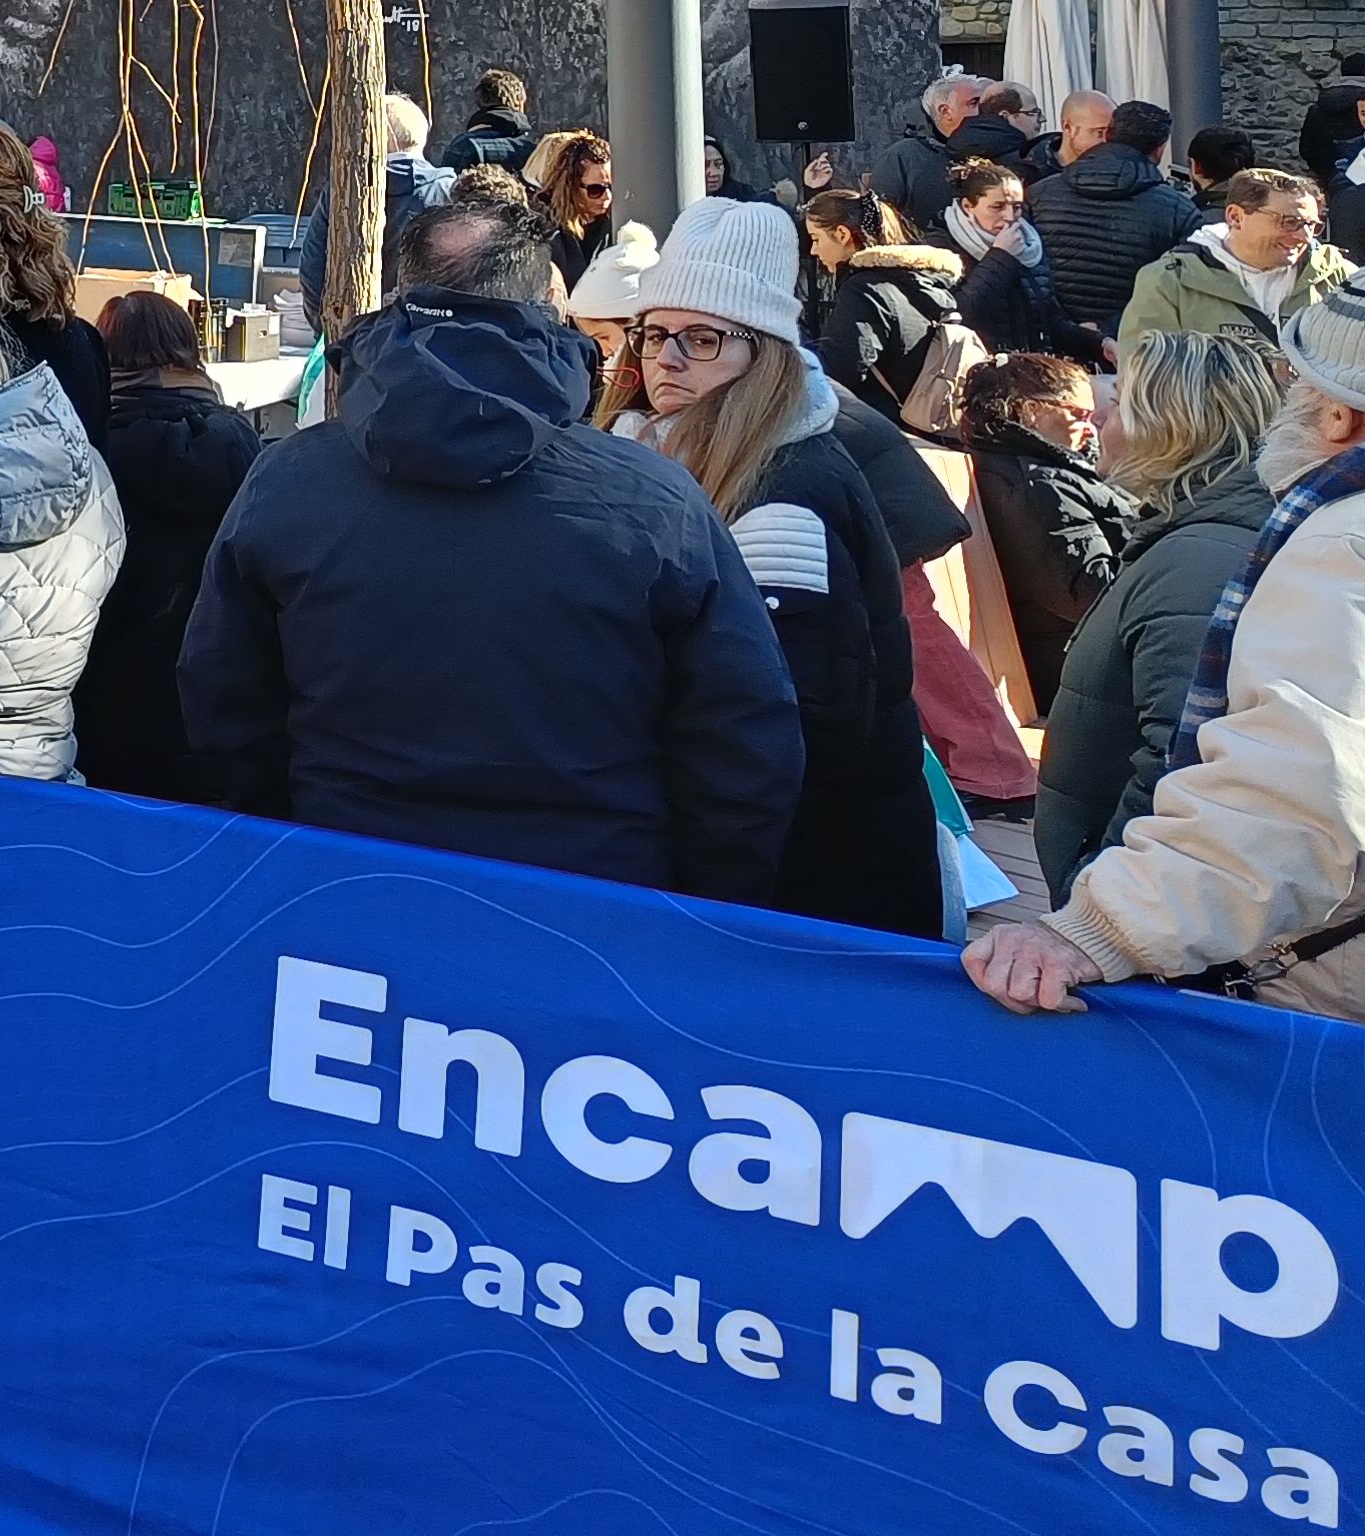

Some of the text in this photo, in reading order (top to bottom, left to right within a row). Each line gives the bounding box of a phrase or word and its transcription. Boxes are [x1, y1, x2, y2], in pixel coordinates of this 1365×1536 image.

[267, 953, 1342, 1354] Encamp
[256, 1171, 1341, 1532] El Pas de la Casa
